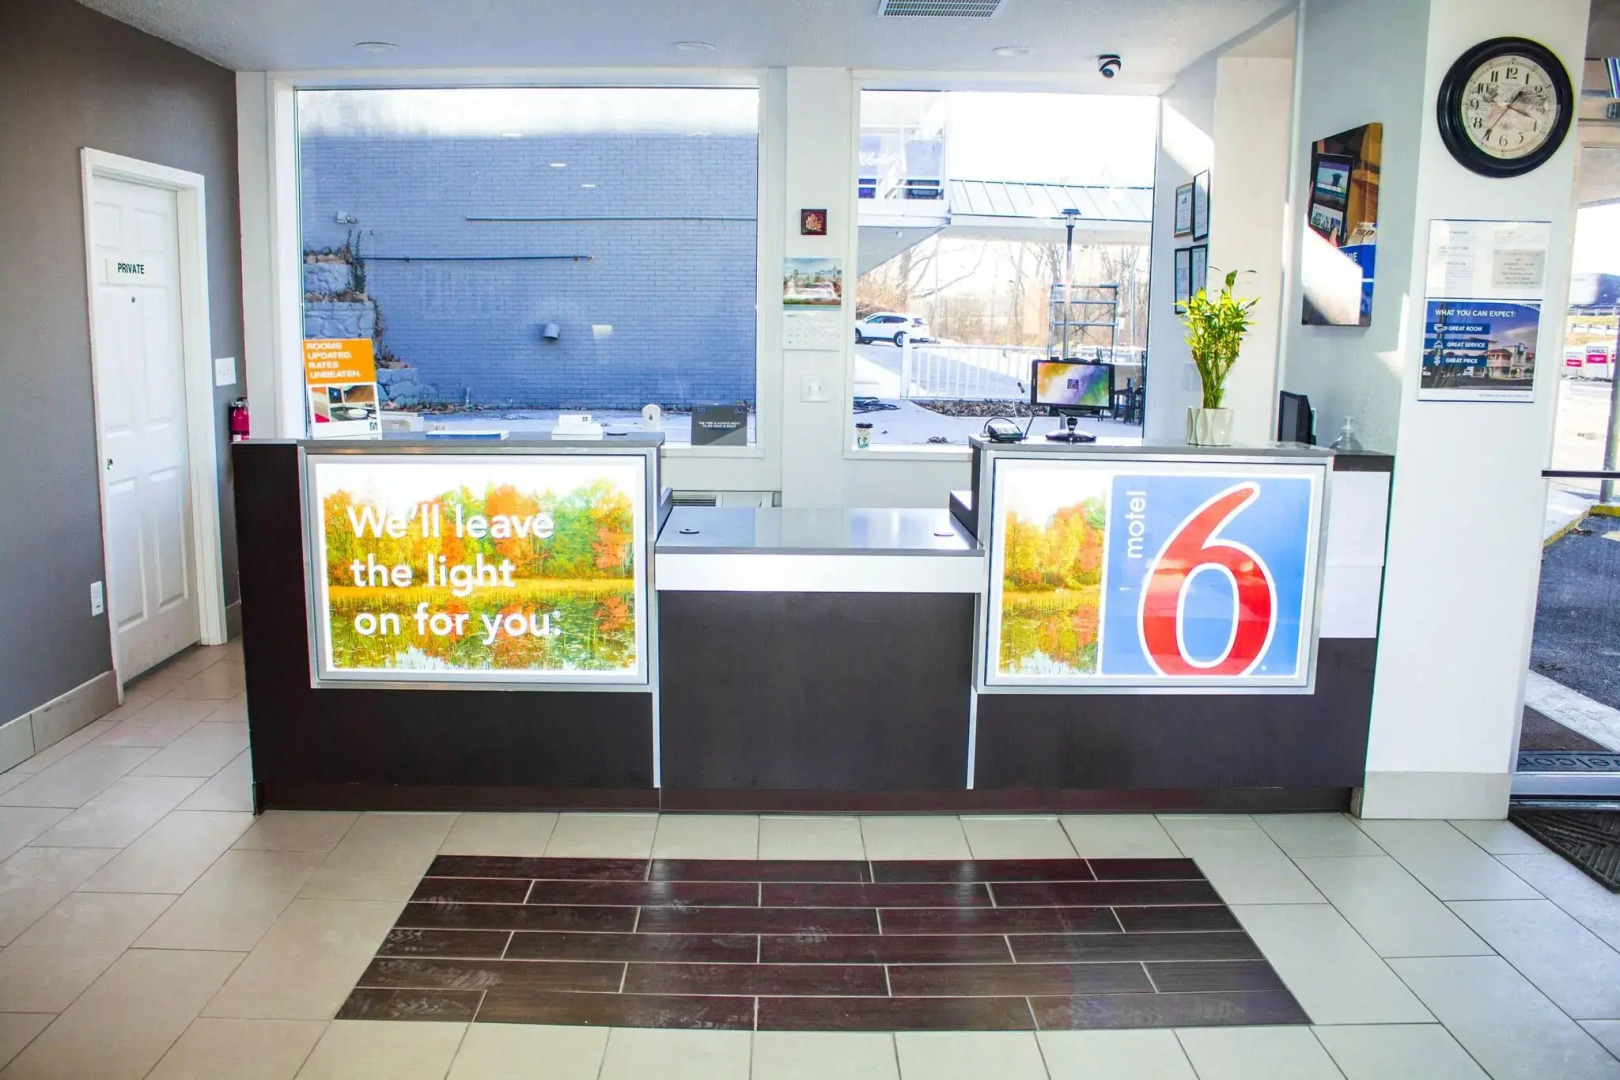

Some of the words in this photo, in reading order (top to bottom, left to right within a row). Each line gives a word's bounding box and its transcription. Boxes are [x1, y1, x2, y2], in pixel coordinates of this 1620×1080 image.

[1490, 70, 1499, 82] 11
[1506, 67, 1518, 80] 12
[1525, 73, 1530, 84] 1
[1477, 82, 1489, 94] 10
[1534, 85, 1543, 98] 2
[1470, 98, 1479, 110] 9
[1473, 117, 1482, 129] 8
[1499, 136, 1508, 147] 6
[1514, 132, 1524, 144] 5
[117, 262, 144, 274] PRIVATE
[306, 342, 342, 350] ROOMS
[307, 352, 352, 360] UPDATED.
[346, 504, 440, 538] We'll
[454, 504, 555, 538] leave
[350, 553, 413, 588] the
[427, 553, 516, 597] light
[1125, 491, 1146, 558] motel
[1136, 480, 1278, 678] 6
[354, 612, 400, 636] on
[414, 602, 470, 636] for
